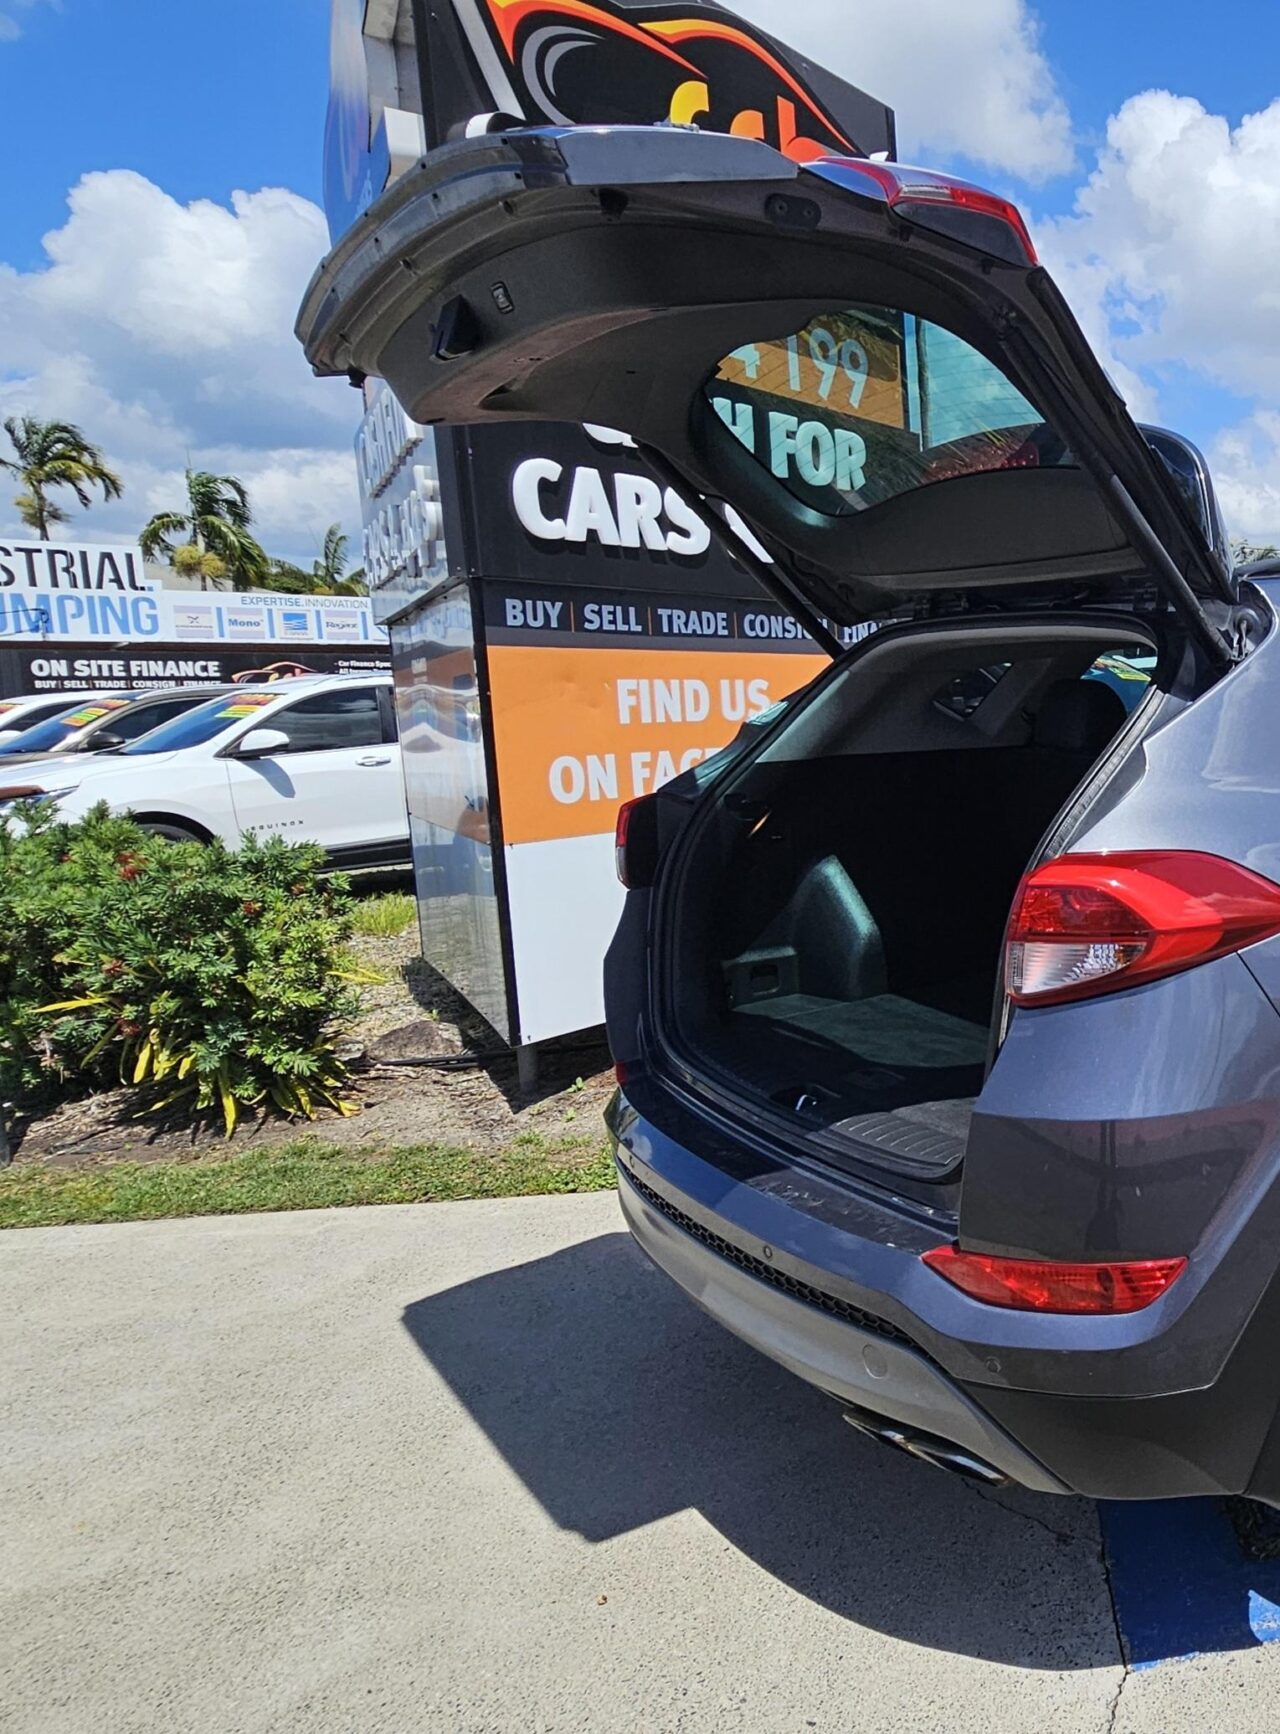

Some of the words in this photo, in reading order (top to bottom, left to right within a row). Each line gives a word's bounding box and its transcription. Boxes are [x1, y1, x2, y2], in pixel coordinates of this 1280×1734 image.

[768, 411, 866, 491] FOR
[512, 457, 712, 555] CARS
[505, 598, 562, 628] BUY
[583, 603, 642, 632] SELL
[657, 608, 729, 636] TRADE
[31, 658, 69, 677] ON
[73, 659, 128, 677] SITE
[129, 660, 221, 677] FINANCE
[34, 680, 57, 689] BUY
[63, 680, 89, 689] SELL
[93, 680, 127, 689] TRADE
[132, 680, 176, 689] CONSIGN
[616, 678, 710, 725] FIND
[720, 678, 771, 722] US
[548, 754, 619, 805] ON
